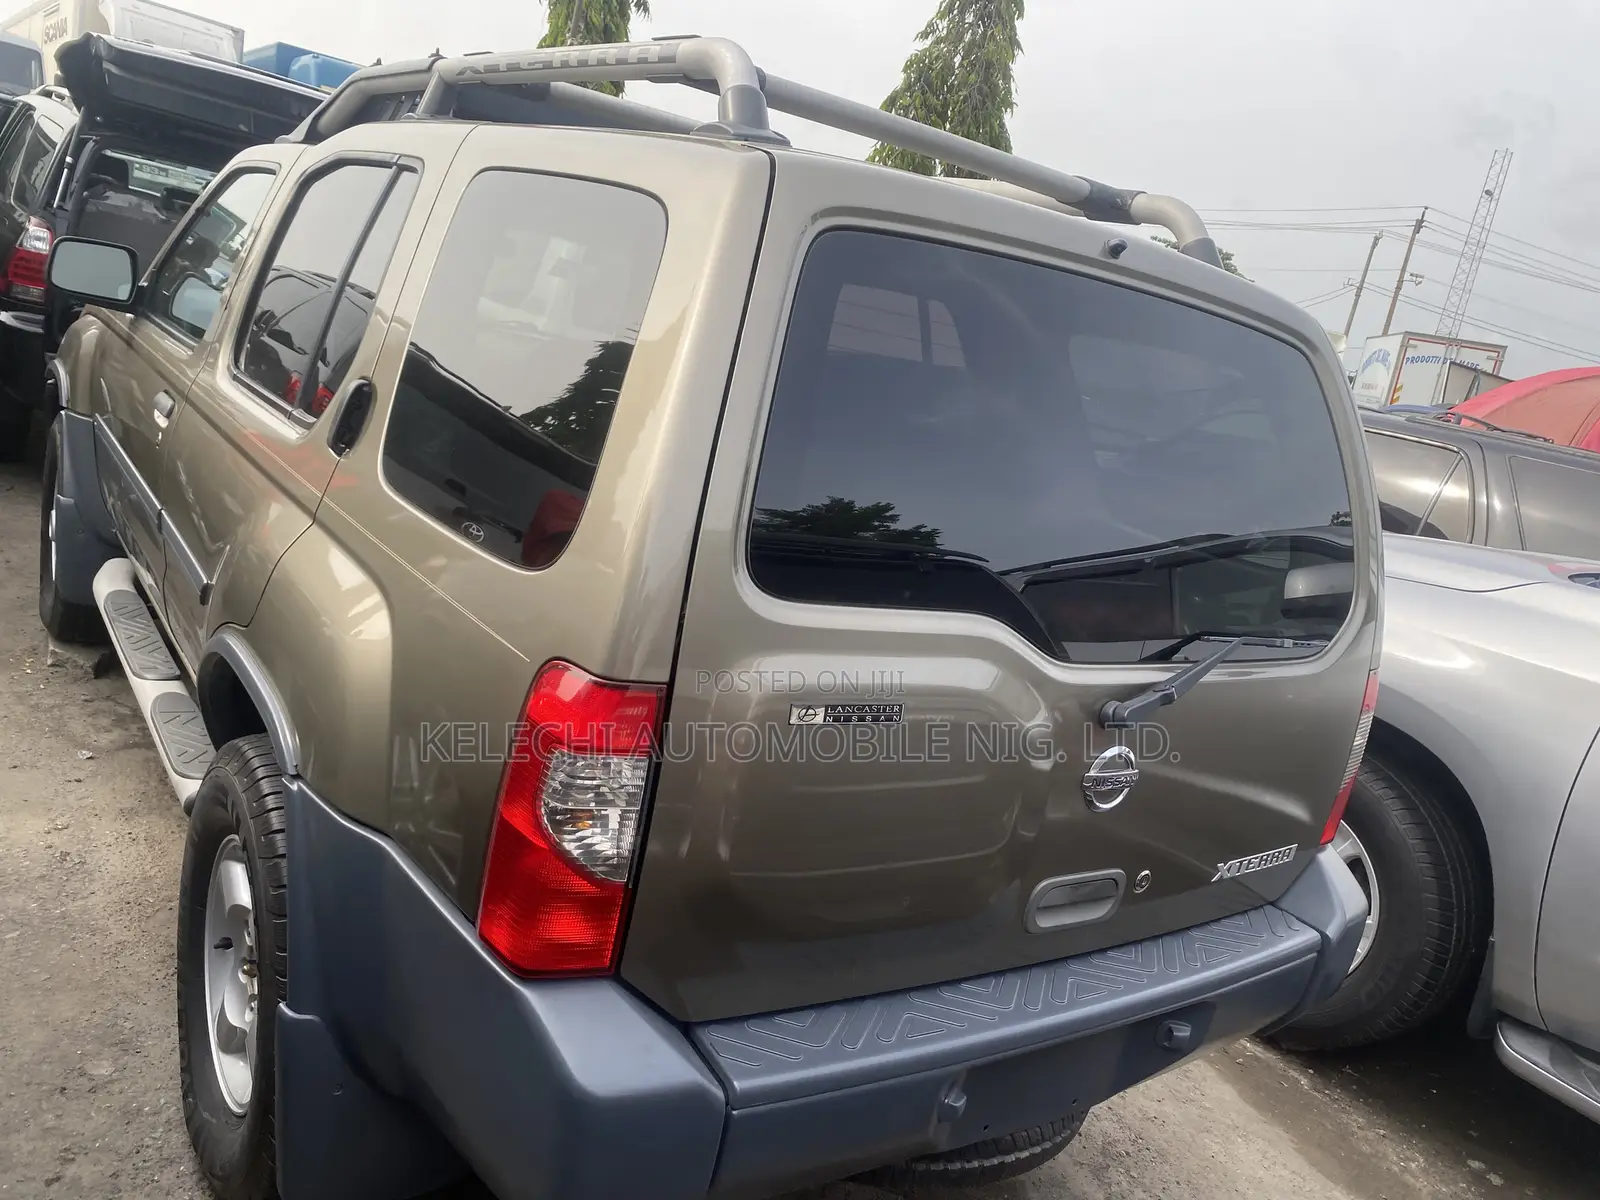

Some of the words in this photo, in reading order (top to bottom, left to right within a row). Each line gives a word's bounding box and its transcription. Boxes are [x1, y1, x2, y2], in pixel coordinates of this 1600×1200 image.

[44, 17, 68, 44] SCANIA
[1404, 355, 1442, 365] PRODOTTI
[827, 704, 900, 713] LANCASTER
[825, 715, 900, 723] NISSAN
[1090, 774, 1139, 789] NISSAN
[1210, 843, 1298, 882] XTERRA
